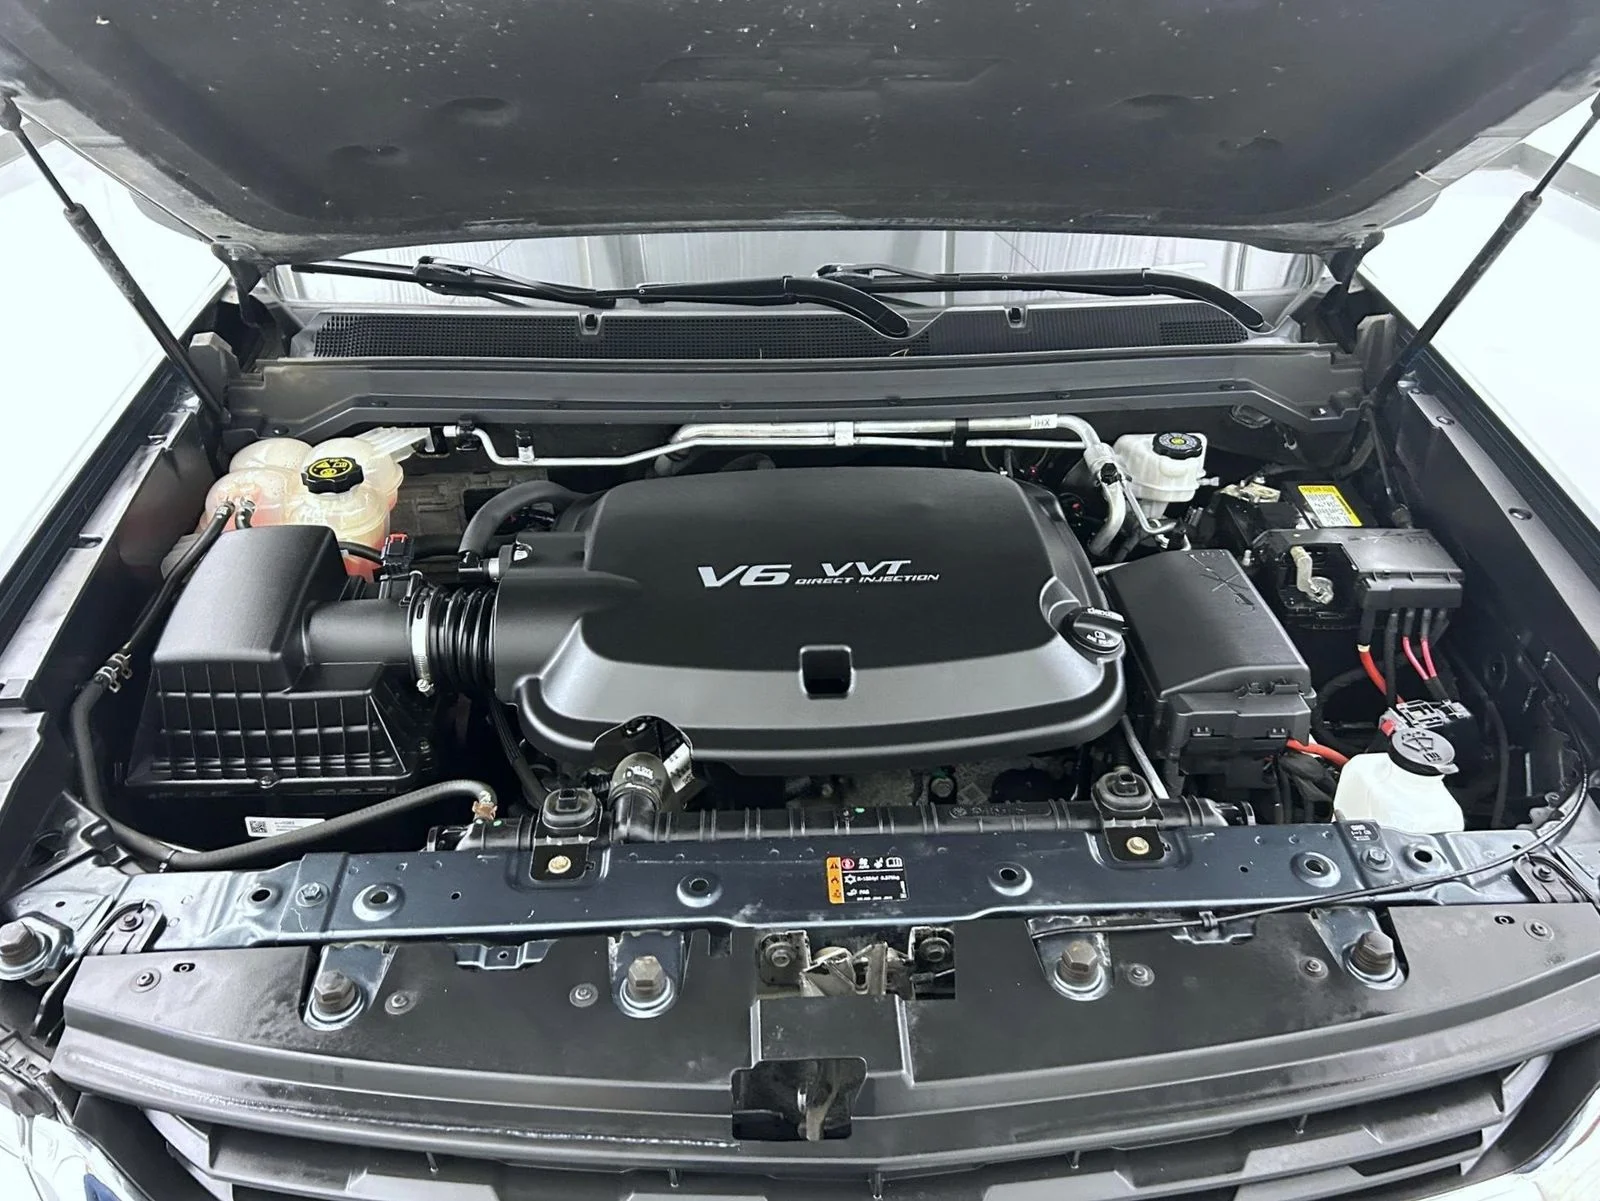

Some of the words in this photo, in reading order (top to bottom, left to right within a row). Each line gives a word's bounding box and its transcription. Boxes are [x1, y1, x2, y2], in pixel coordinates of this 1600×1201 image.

[697, 564, 792, 588] V6
[821, 560, 911, 577] VVT
[795, 577, 854, 585] DIRECT
[858, 574, 940, 584] INJECTION
